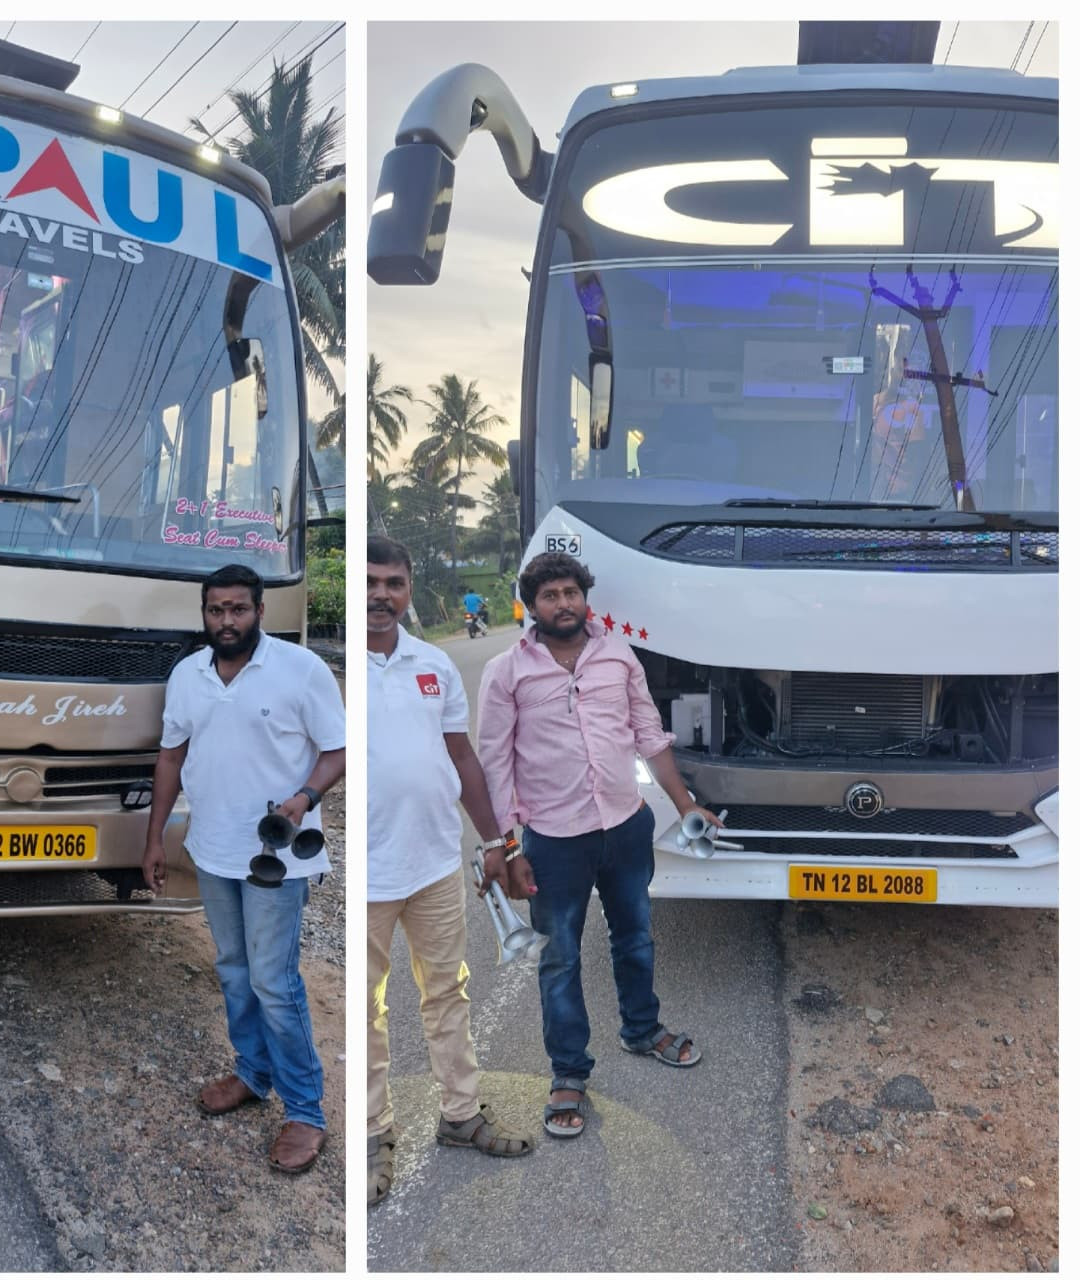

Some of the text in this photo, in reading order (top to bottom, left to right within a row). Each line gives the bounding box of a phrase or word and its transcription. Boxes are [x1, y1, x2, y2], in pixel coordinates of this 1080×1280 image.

[214, 501, 274, 525] Executive
[163, 526, 201, 544] Seat
[204, 529, 240, 549] Cum
[9, 833, 39, 857] BW
[43, 833, 86, 857] 0366
[803, 872, 924, 895] TN 12 BL 2088
